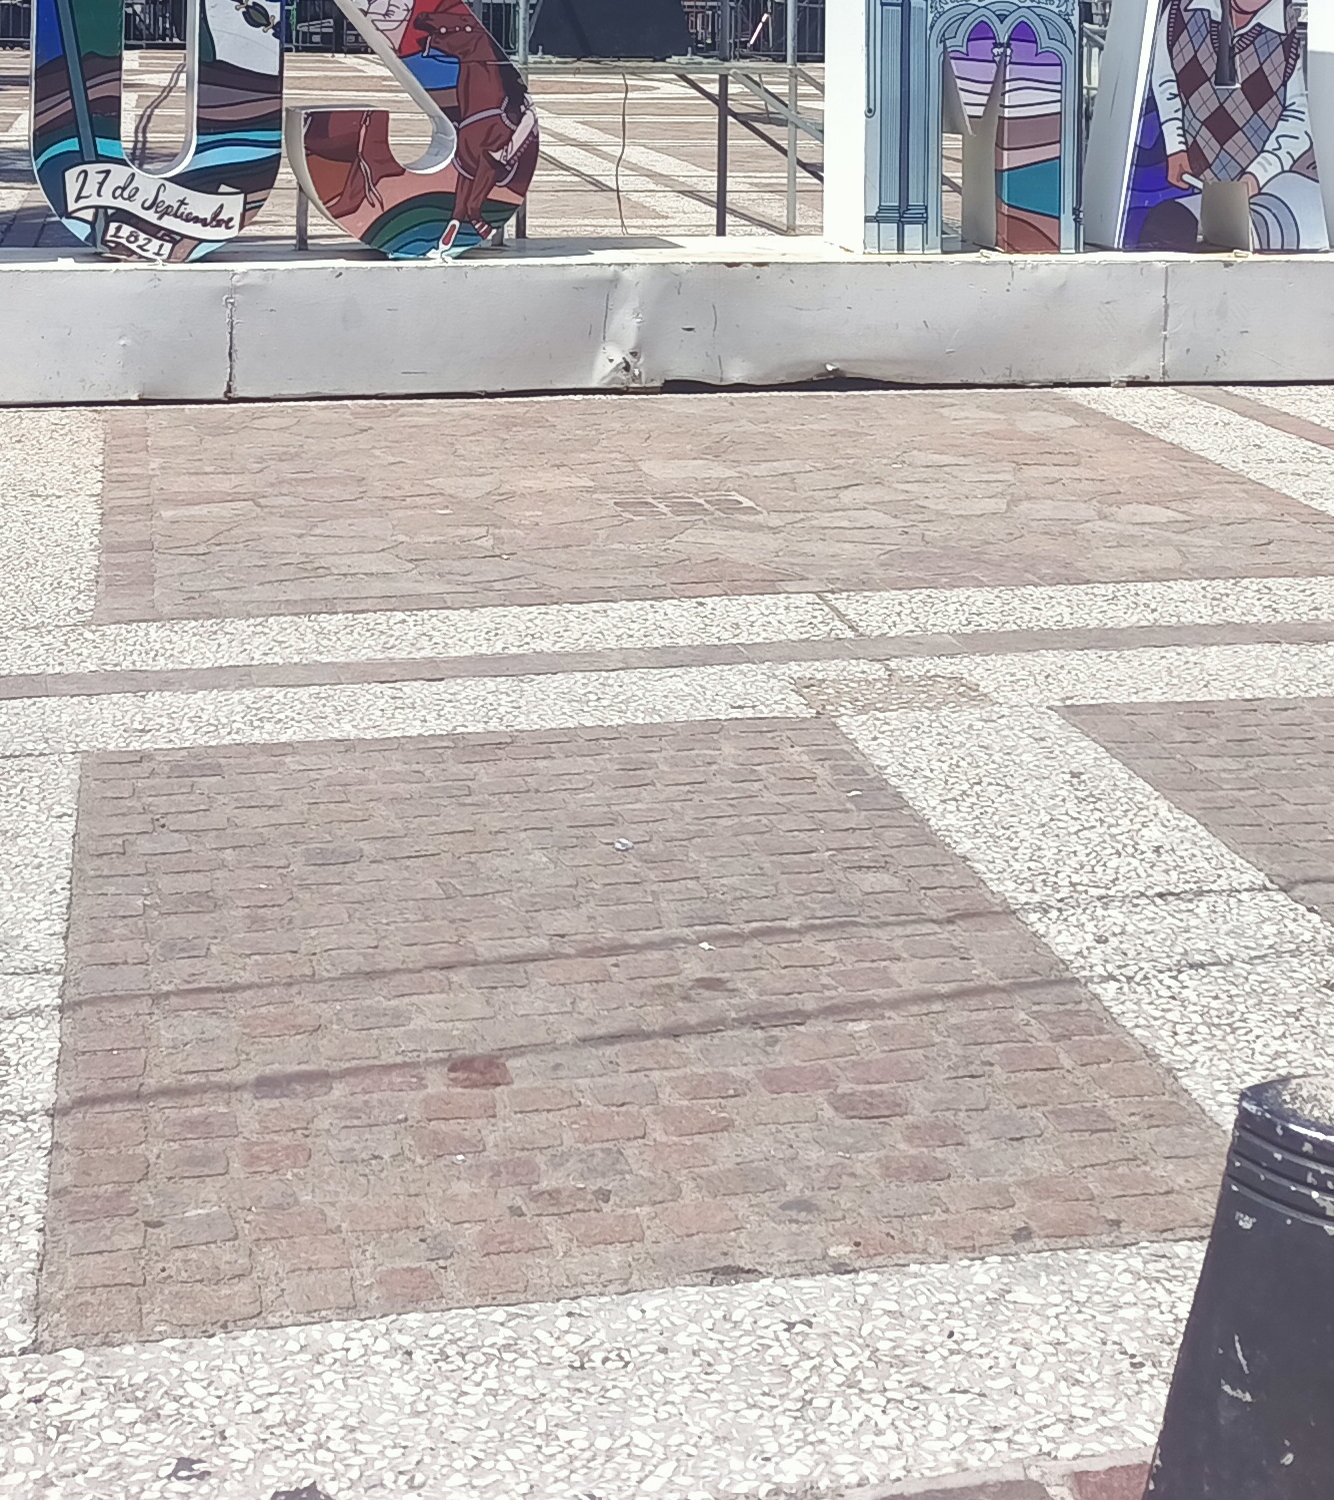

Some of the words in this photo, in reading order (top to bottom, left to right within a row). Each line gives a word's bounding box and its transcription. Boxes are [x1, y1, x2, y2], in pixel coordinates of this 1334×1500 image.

[74, 169, 111, 203] 27
[112, 172, 140, 202] de
[141, 183, 235, 230] Septiembre
[110, 224, 167, 256] 1821
